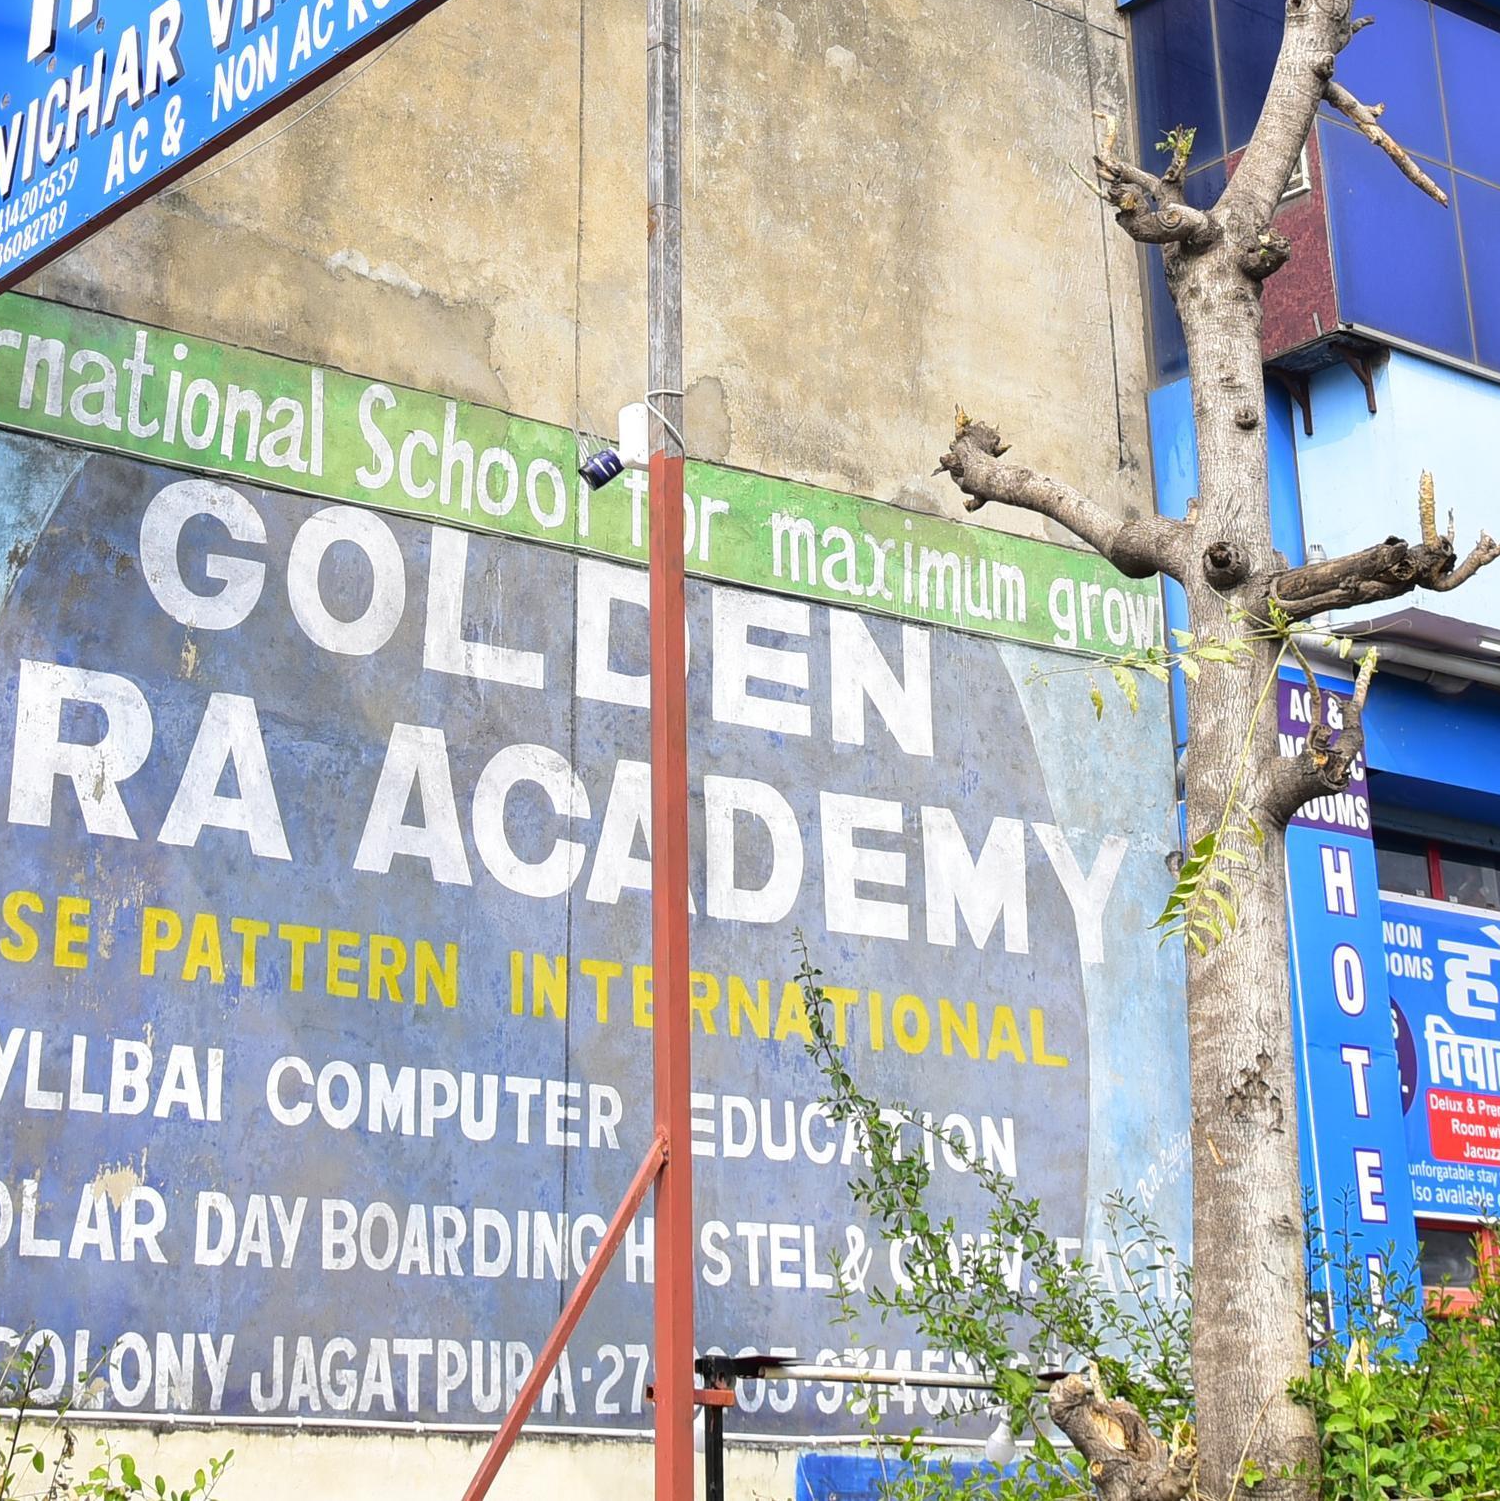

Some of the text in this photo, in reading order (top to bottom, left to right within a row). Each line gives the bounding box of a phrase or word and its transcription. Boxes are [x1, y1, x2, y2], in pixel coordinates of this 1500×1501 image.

[104, 110, 150, 195] AC
[159, 90, 186, 159] &
[211, 30, 280, 126] NON
[139, 478, 935, 758] GOLDEN
[770, 510, 1028, 626] maximum
[352, 721, 1129, 966] ACADEMY
[139, 907, 458, 1009] PATTERN
[509, 950, 1070, 1069] INTERNATIONAL
[1382, 920, 1423, 950] NON
[266, 1055, 624, 1152] COMPUTER
[690, 1091, 1019, 1179] EDUCATION
[1318, 844, 1399, 1333] HOTEL
[1429, 1093, 1464, 1114] Delux
[1466, 1098, 1477, 1117] &
[1450, 1119, 1486, 1139] Room
[1411, 1180, 1432, 1203] lso
[1434, 1184, 1495, 1209] available
[1476, 1167, 1498, 1189] stay
[194, 1191, 311, 1271] DAY
[321, 1199, 608, 1287] BOARDING
[623, 1216, 836, 1293] HSTEL
[838, 1223, 874, 1295] &
